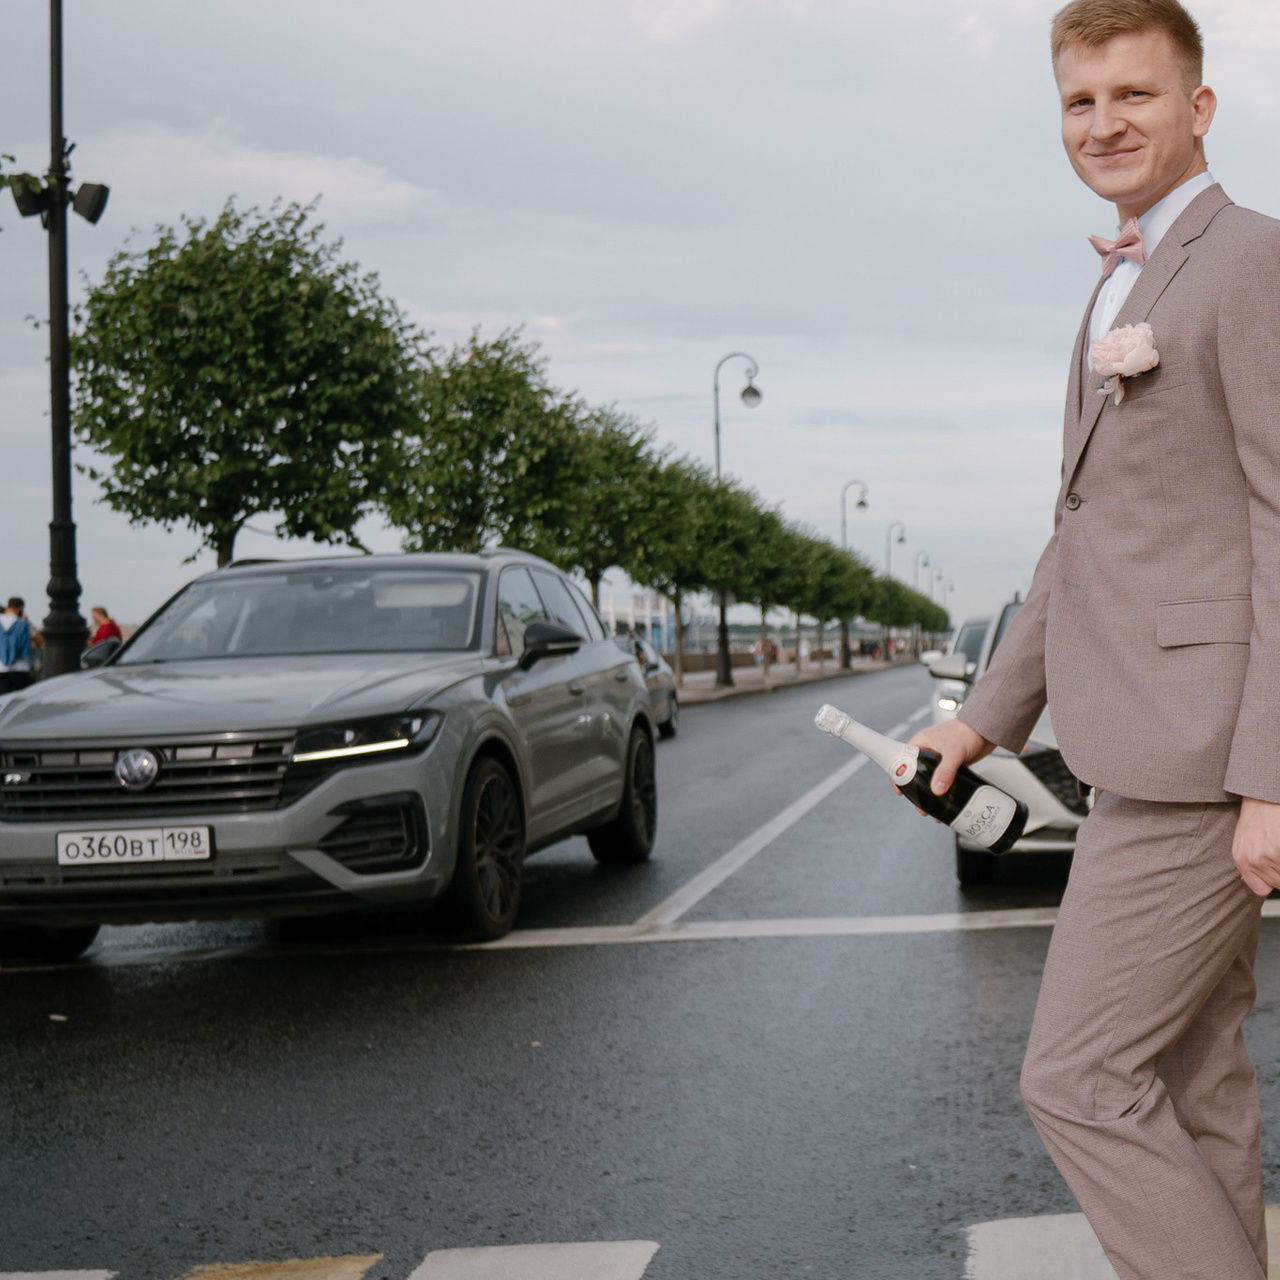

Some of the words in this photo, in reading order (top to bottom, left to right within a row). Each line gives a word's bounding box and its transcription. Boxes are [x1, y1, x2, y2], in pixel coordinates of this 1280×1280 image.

[117, 749, 157, 789] VW
[966, 805, 995, 836] BOSCA
[166, 831, 202, 850] 198
